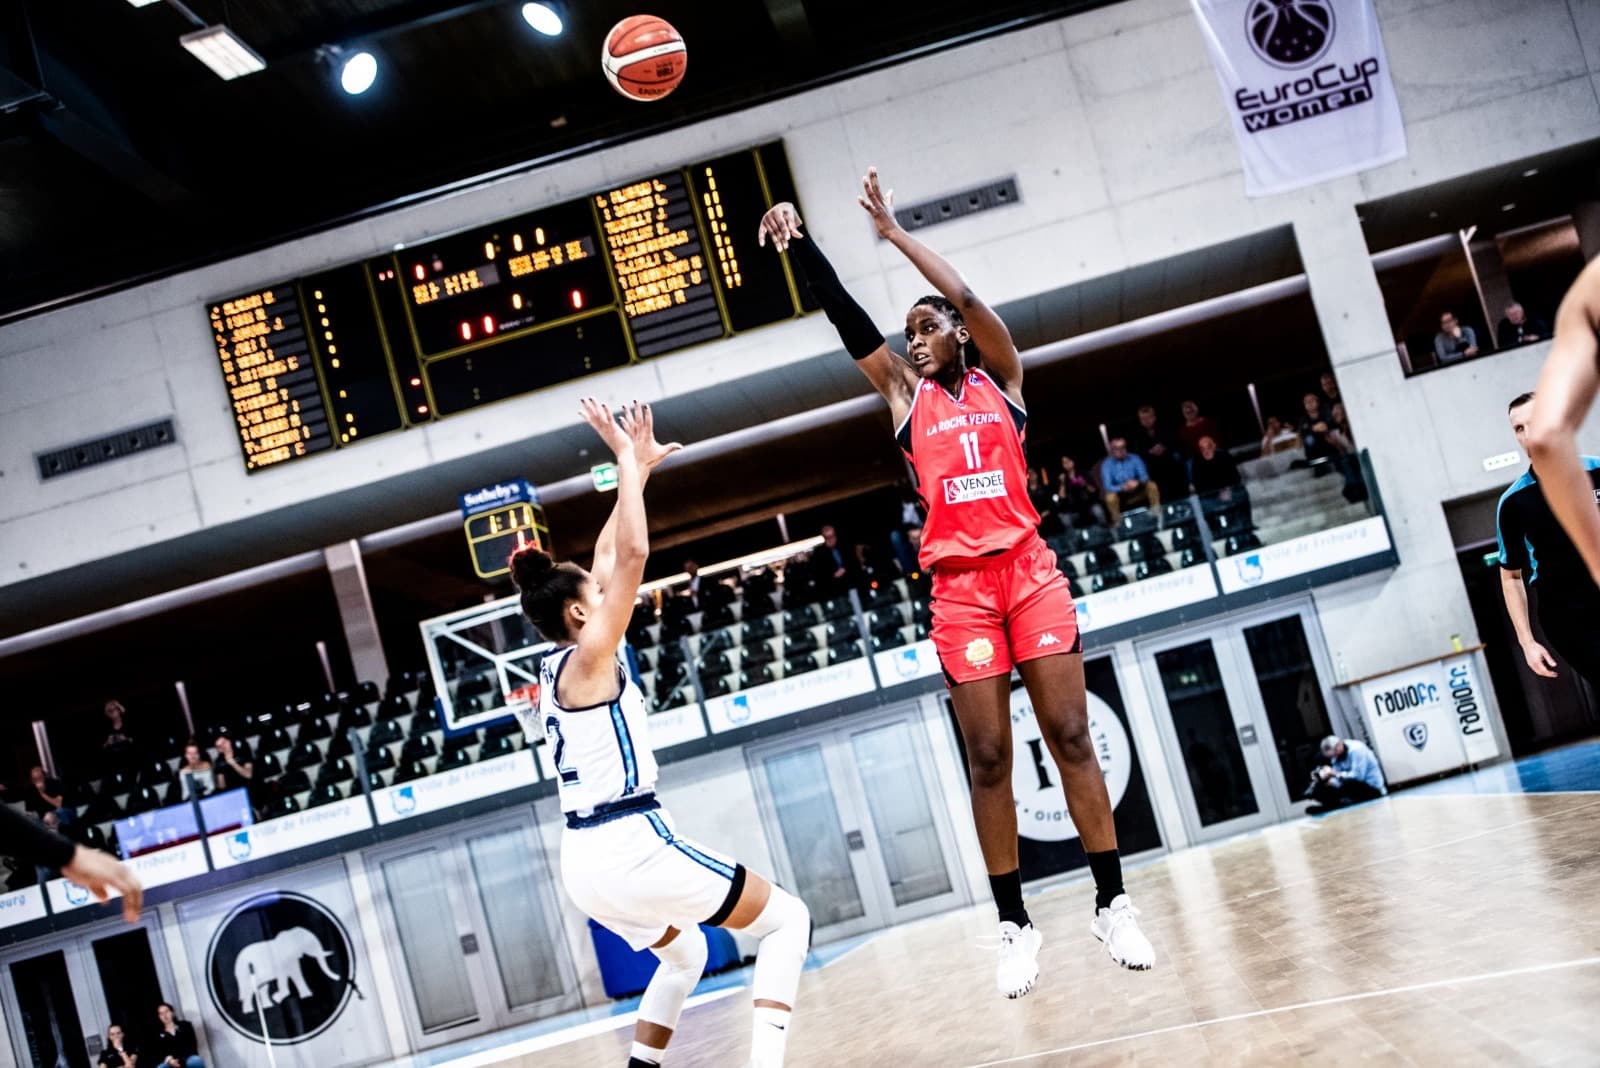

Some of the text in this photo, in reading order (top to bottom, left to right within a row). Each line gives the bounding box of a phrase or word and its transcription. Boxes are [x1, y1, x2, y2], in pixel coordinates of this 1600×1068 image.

[1235, 57, 1379, 111] EuroCup
[1244, 85, 1371, 131] women
[926, 424, 938, 437] LA
[938, 414, 968, 433] ROCHE
[959, 431, 981, 470] 11
